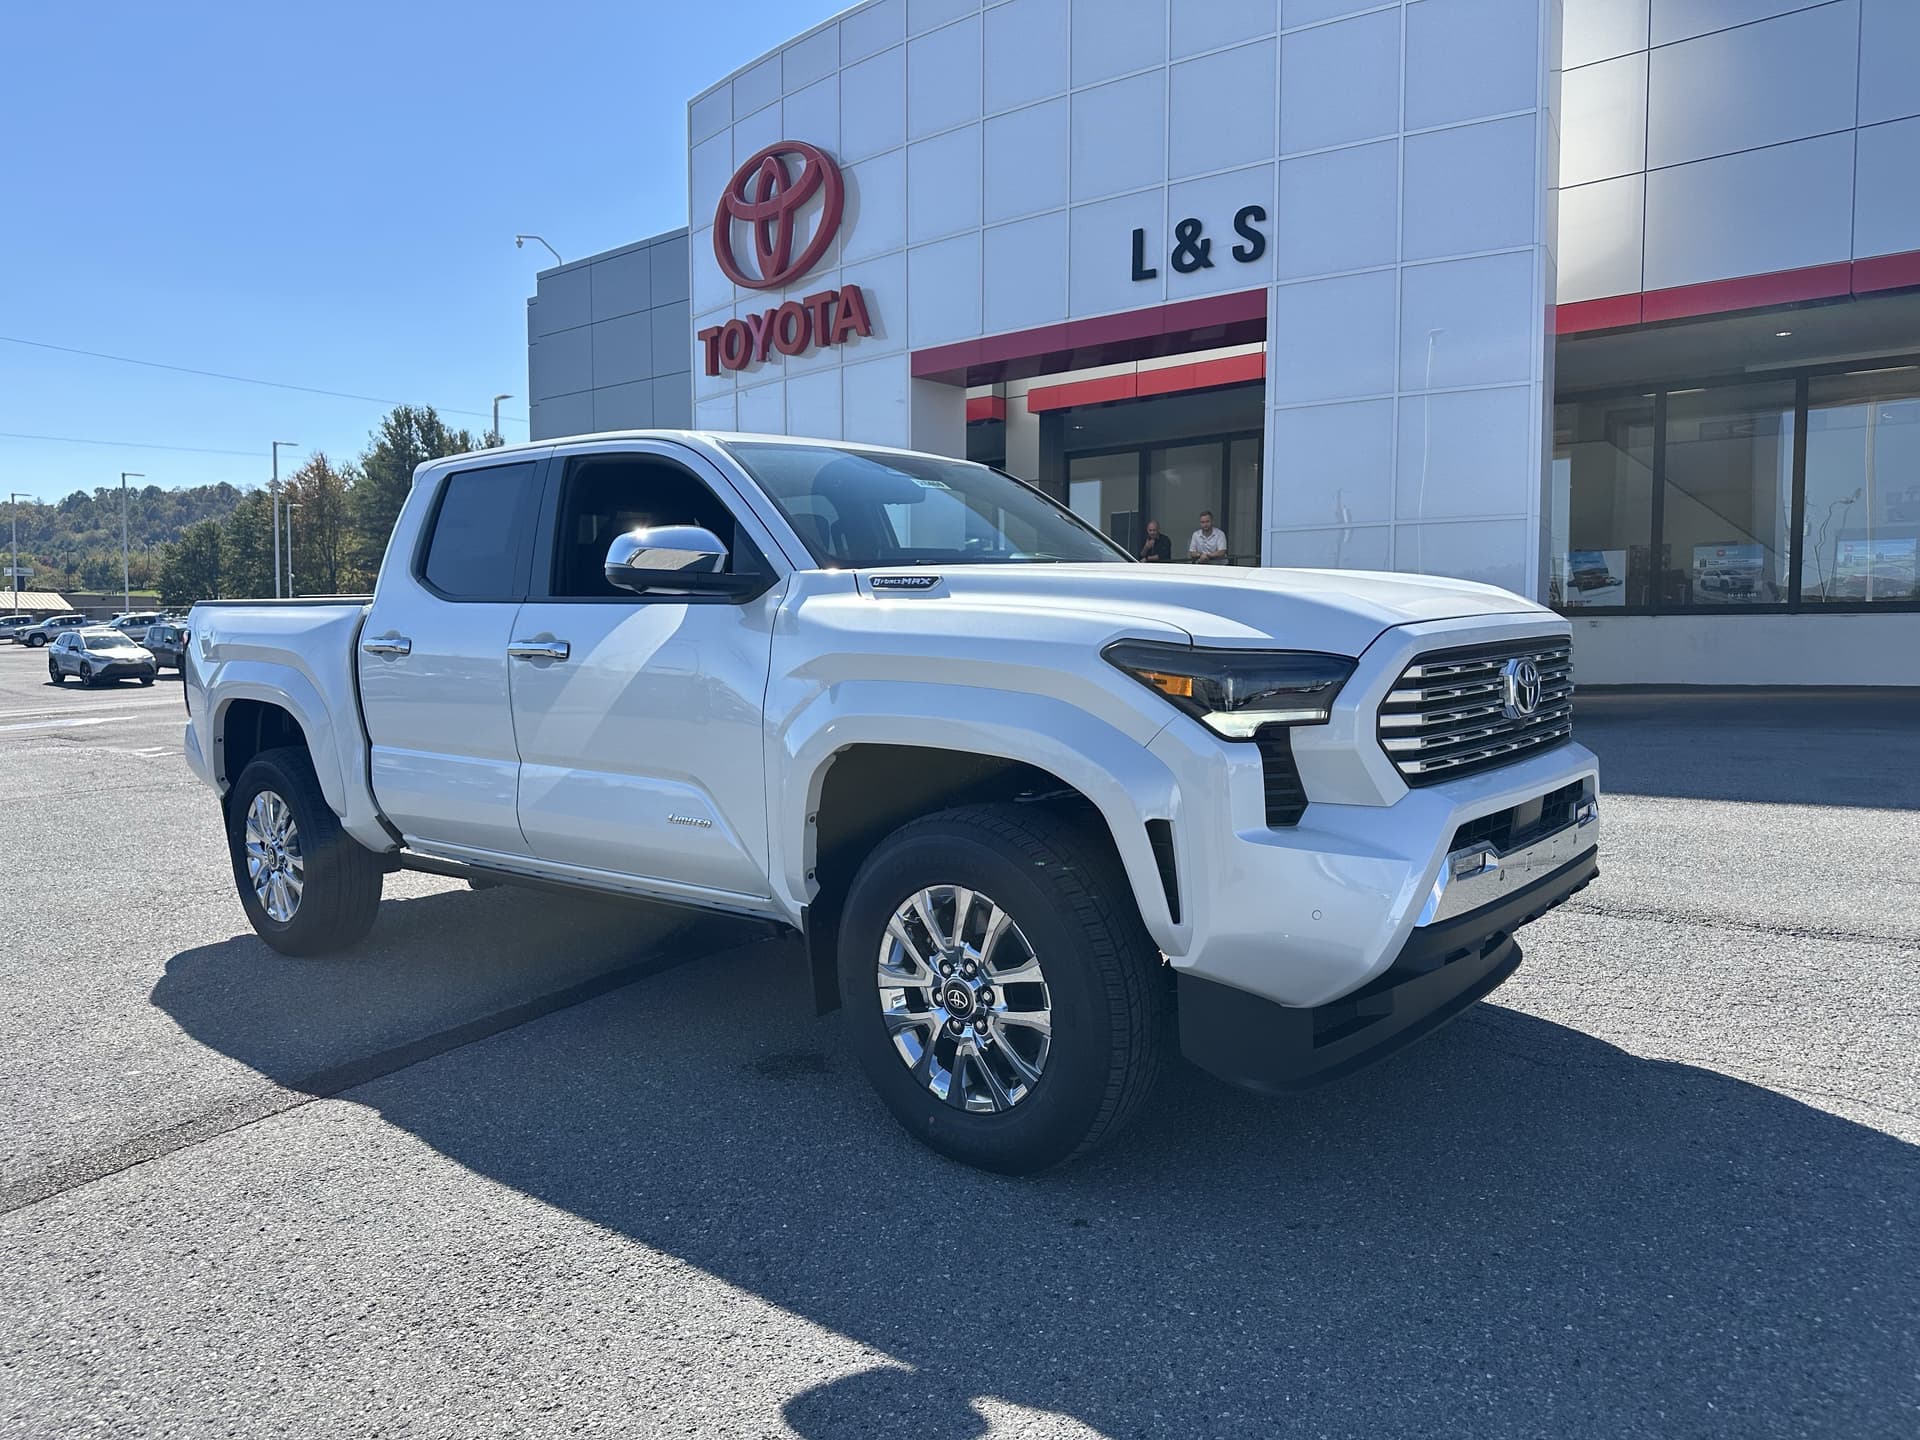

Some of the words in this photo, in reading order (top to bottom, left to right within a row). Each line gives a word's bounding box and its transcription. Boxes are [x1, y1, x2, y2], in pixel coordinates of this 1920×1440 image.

[1131, 227, 1157, 281] L
[1171, 217, 1215, 273] &
[1231, 205, 1266, 263] S
[697, 284, 873, 376] TOYOTA
